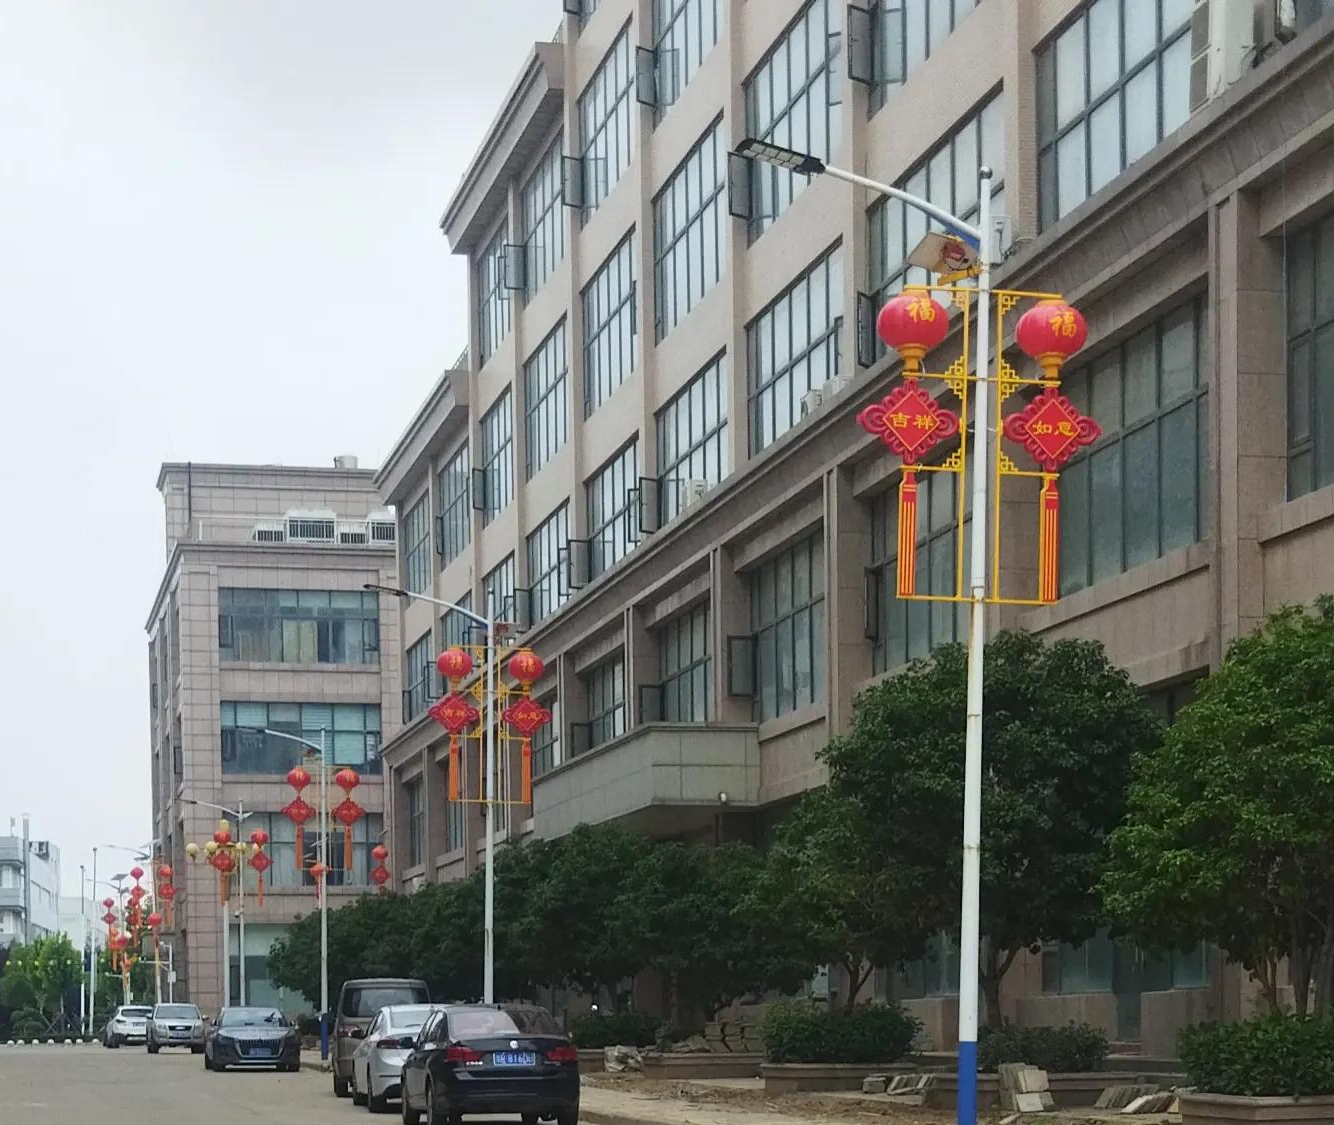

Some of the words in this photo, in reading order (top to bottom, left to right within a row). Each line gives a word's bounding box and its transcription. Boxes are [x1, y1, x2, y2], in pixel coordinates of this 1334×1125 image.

[906, 298, 936, 323] 福
[1049, 312, 1077, 337] 福
[889, 413, 934, 430] 吉祥
[1033, 423, 1074, 437] 如意
